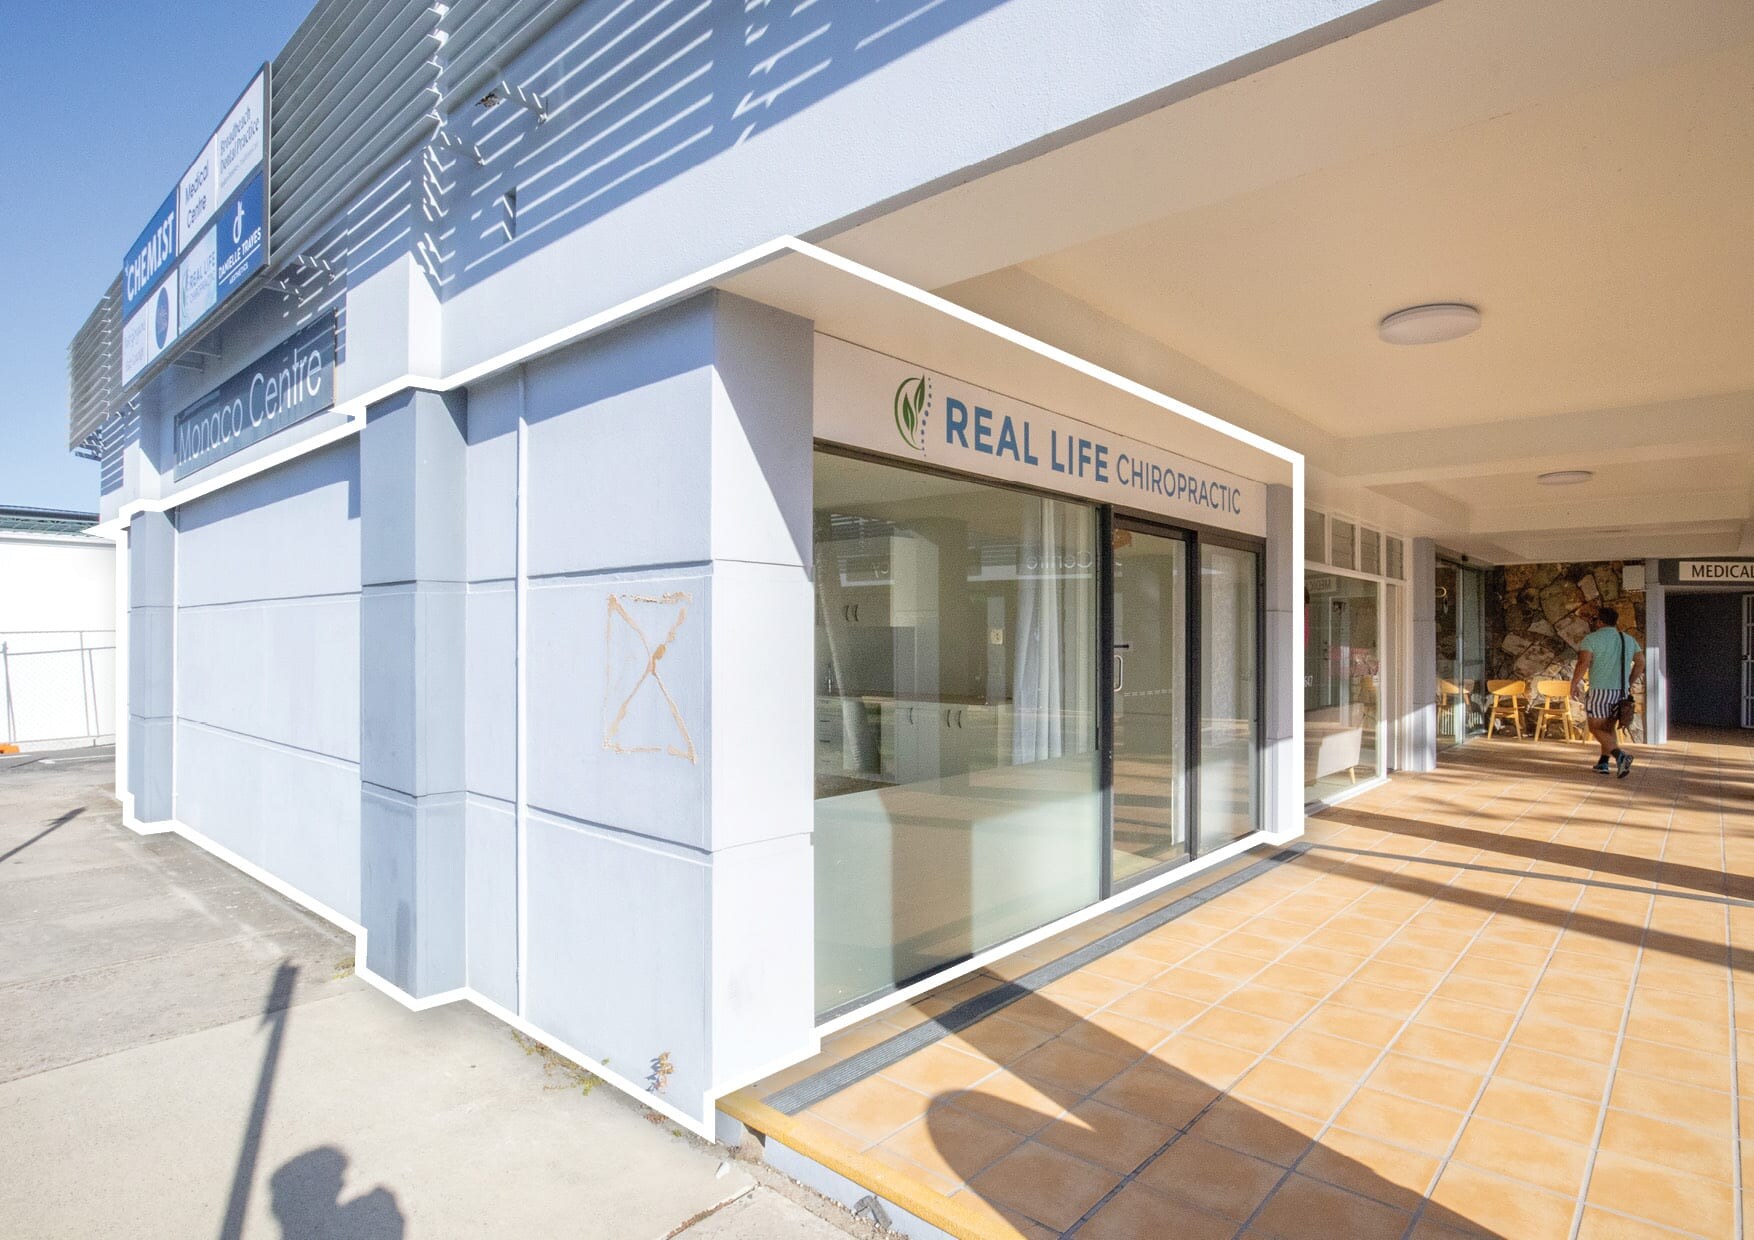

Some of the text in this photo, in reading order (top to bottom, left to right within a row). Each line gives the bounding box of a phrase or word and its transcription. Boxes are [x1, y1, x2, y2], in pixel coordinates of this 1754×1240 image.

[185, 159, 209, 204] Medical
[187, 195, 207, 229] Centre
[127, 211, 175, 302] CHEMIST
[218, 246, 241, 280] DANIELLE
[178, 348, 322, 466] Monaco Centre
[945, 396, 1242, 515] REAL LIFE CHIROPRACTIC
[1691, 564, 1754, 578] MEDICAL
